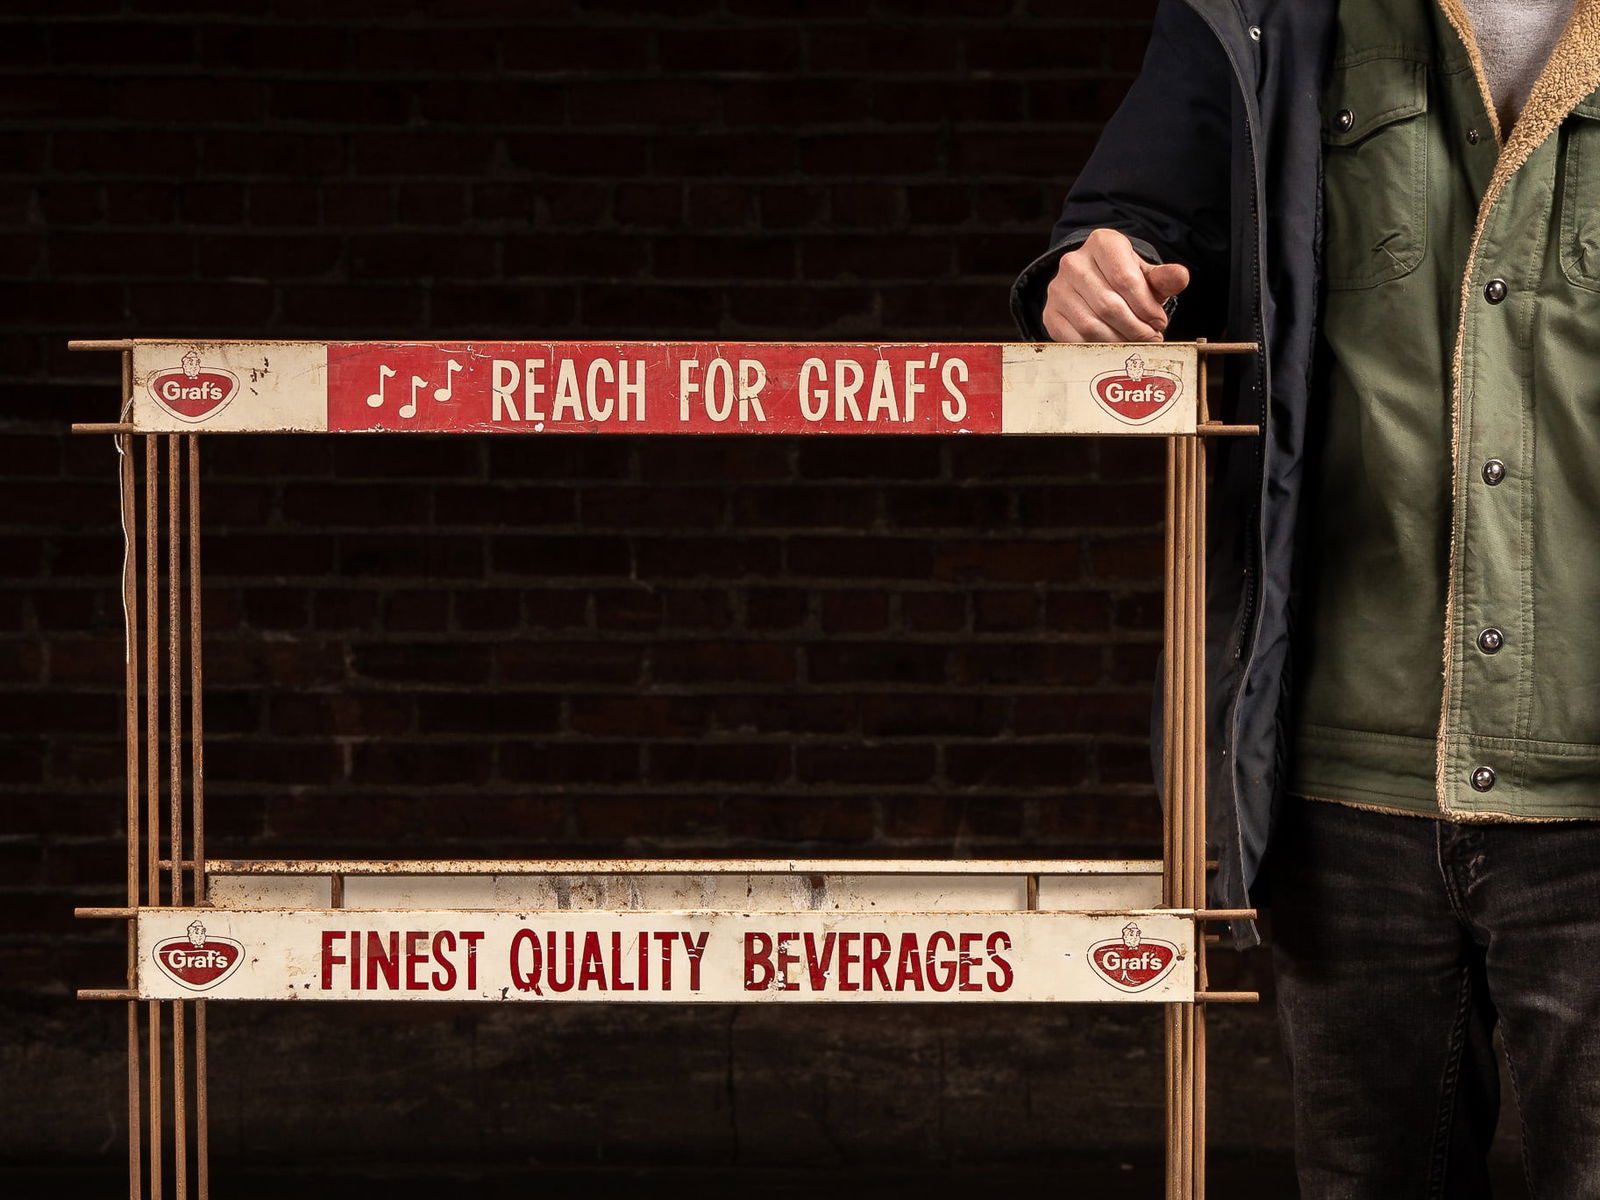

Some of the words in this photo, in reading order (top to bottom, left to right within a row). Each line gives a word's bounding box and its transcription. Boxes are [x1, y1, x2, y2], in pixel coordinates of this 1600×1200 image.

[162, 380, 223, 401] Graf's
[491, 357, 646, 422] REACH
[679, 357, 767, 422] FOR
[799, 351, 969, 423] GRAF'S
[1105, 382, 1166, 403] Graf's
[168, 949, 228, 970] Graf's
[321, 930, 485, 991] FINEST
[509, 928, 710, 996] QUALITY
[743, 930, 1015, 992] BEVERAGES
[1102, 951, 1163, 972] Graf's
